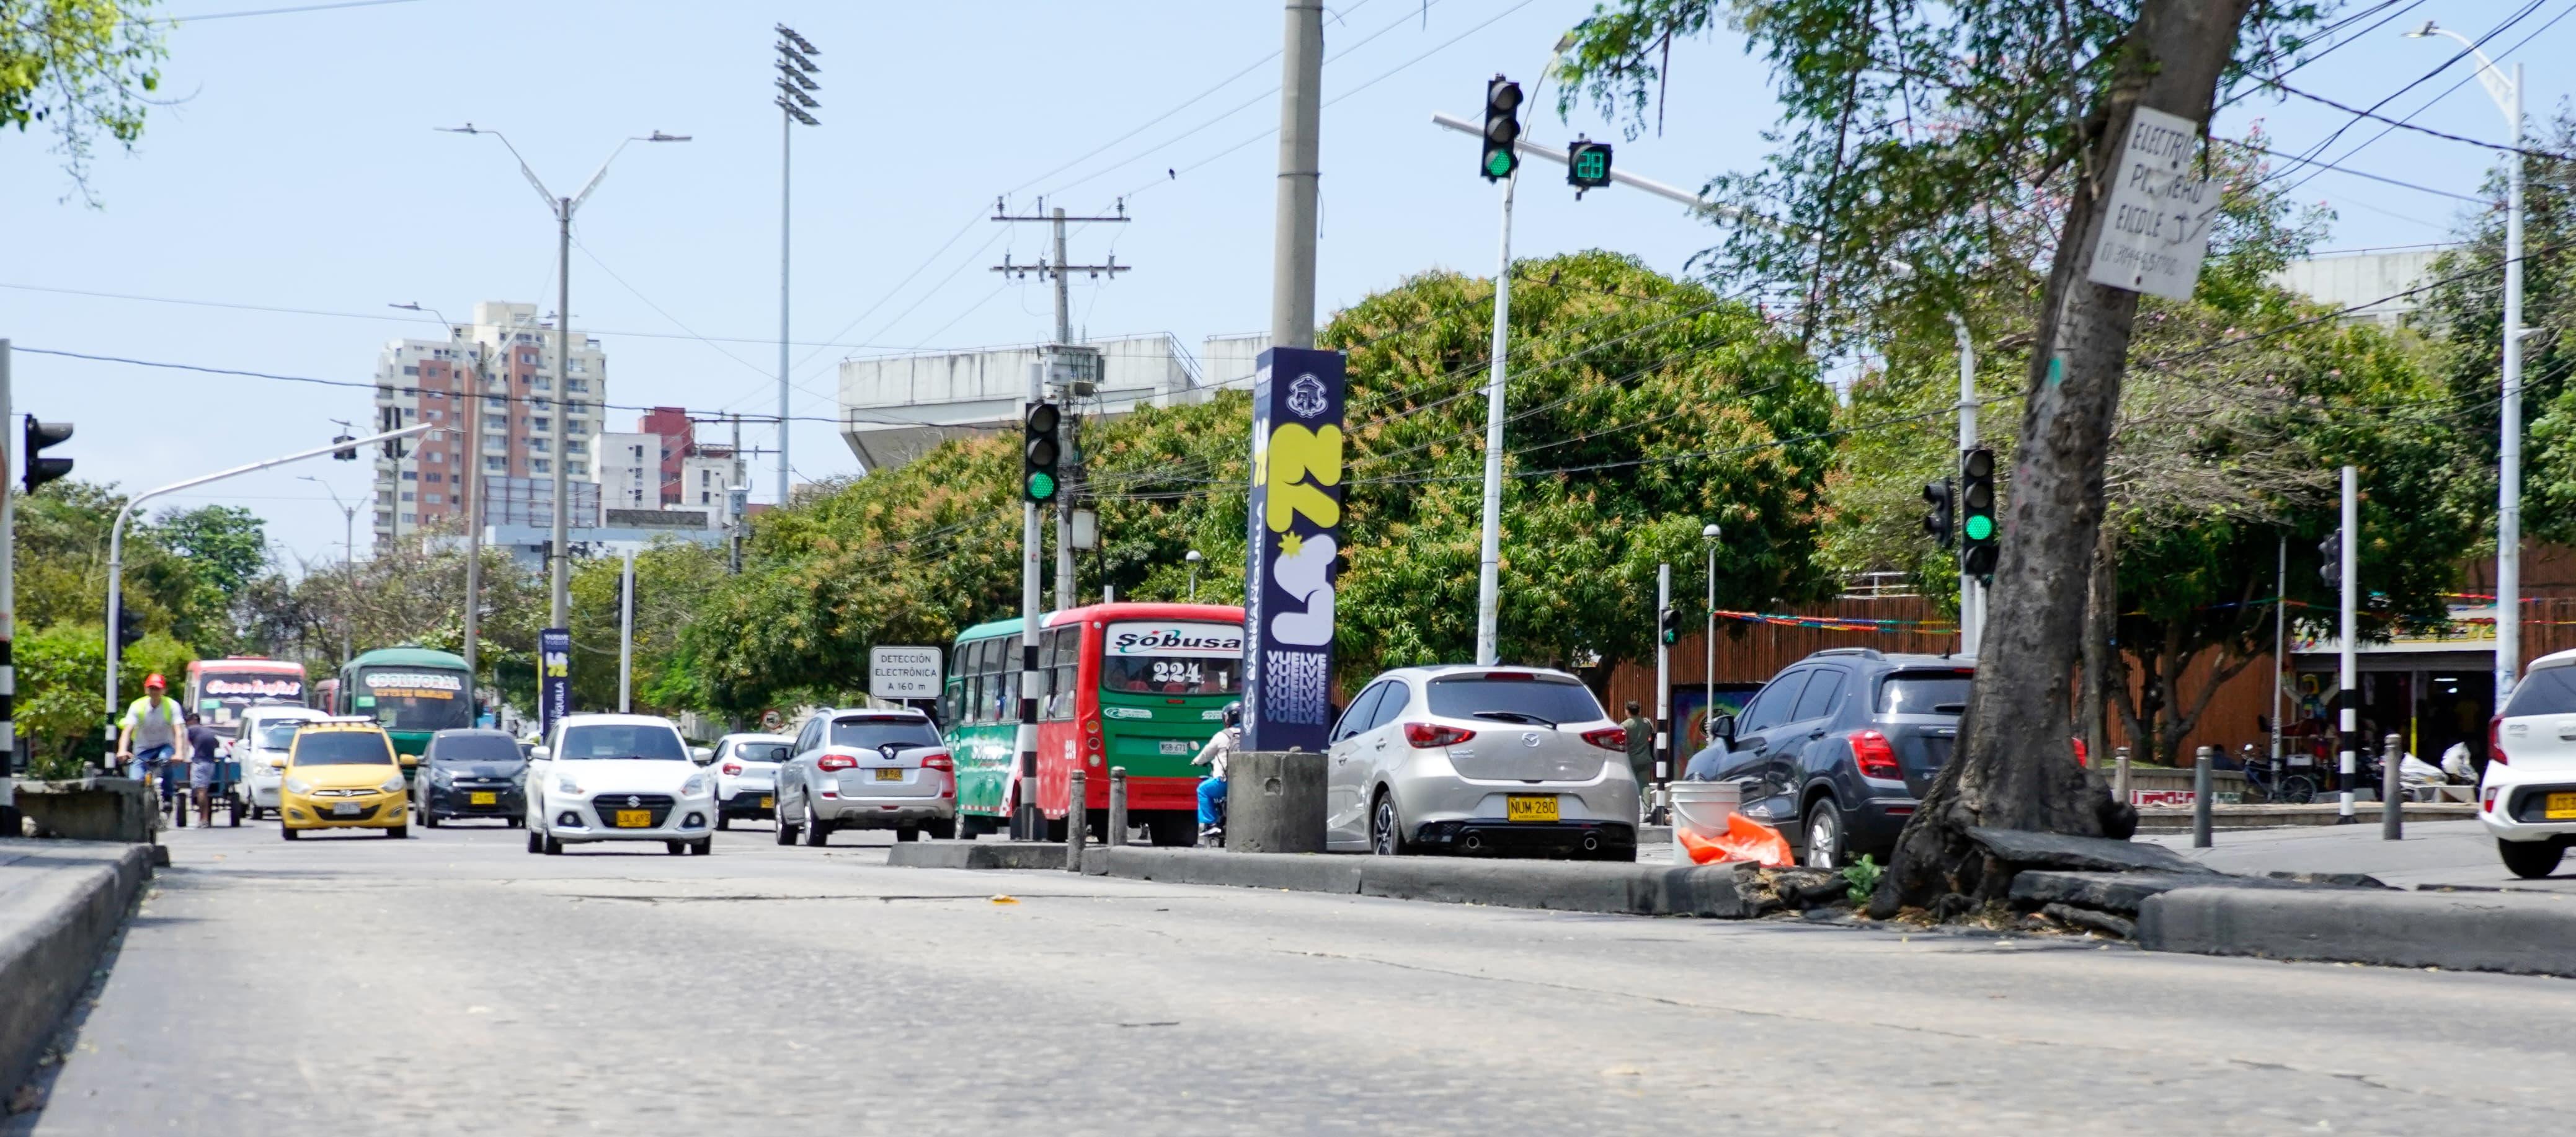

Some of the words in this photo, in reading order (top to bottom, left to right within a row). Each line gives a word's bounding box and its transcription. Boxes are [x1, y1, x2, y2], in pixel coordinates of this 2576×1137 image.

[1577, 151, 1604, 179] 28
[1115, 630, 1241, 652] Sobusa
[881, 653, 931, 663] DETECCIÓN
[1267, 651, 1326, 666] VUELVE
[875, 667, 937, 677] ELECTRÓNICA
[1153, 661, 1203, 684] 224
[1266, 662, 1326, 678] VUELVE
[1266, 674, 1326, 689] VUELVE
[1266, 686, 1325, 701] VUELVE
[1265, 697, 1325, 713] VUELVE
[1265, 709, 1324, 725] VUELVE
[1535, 802, 1556, 813] 280
